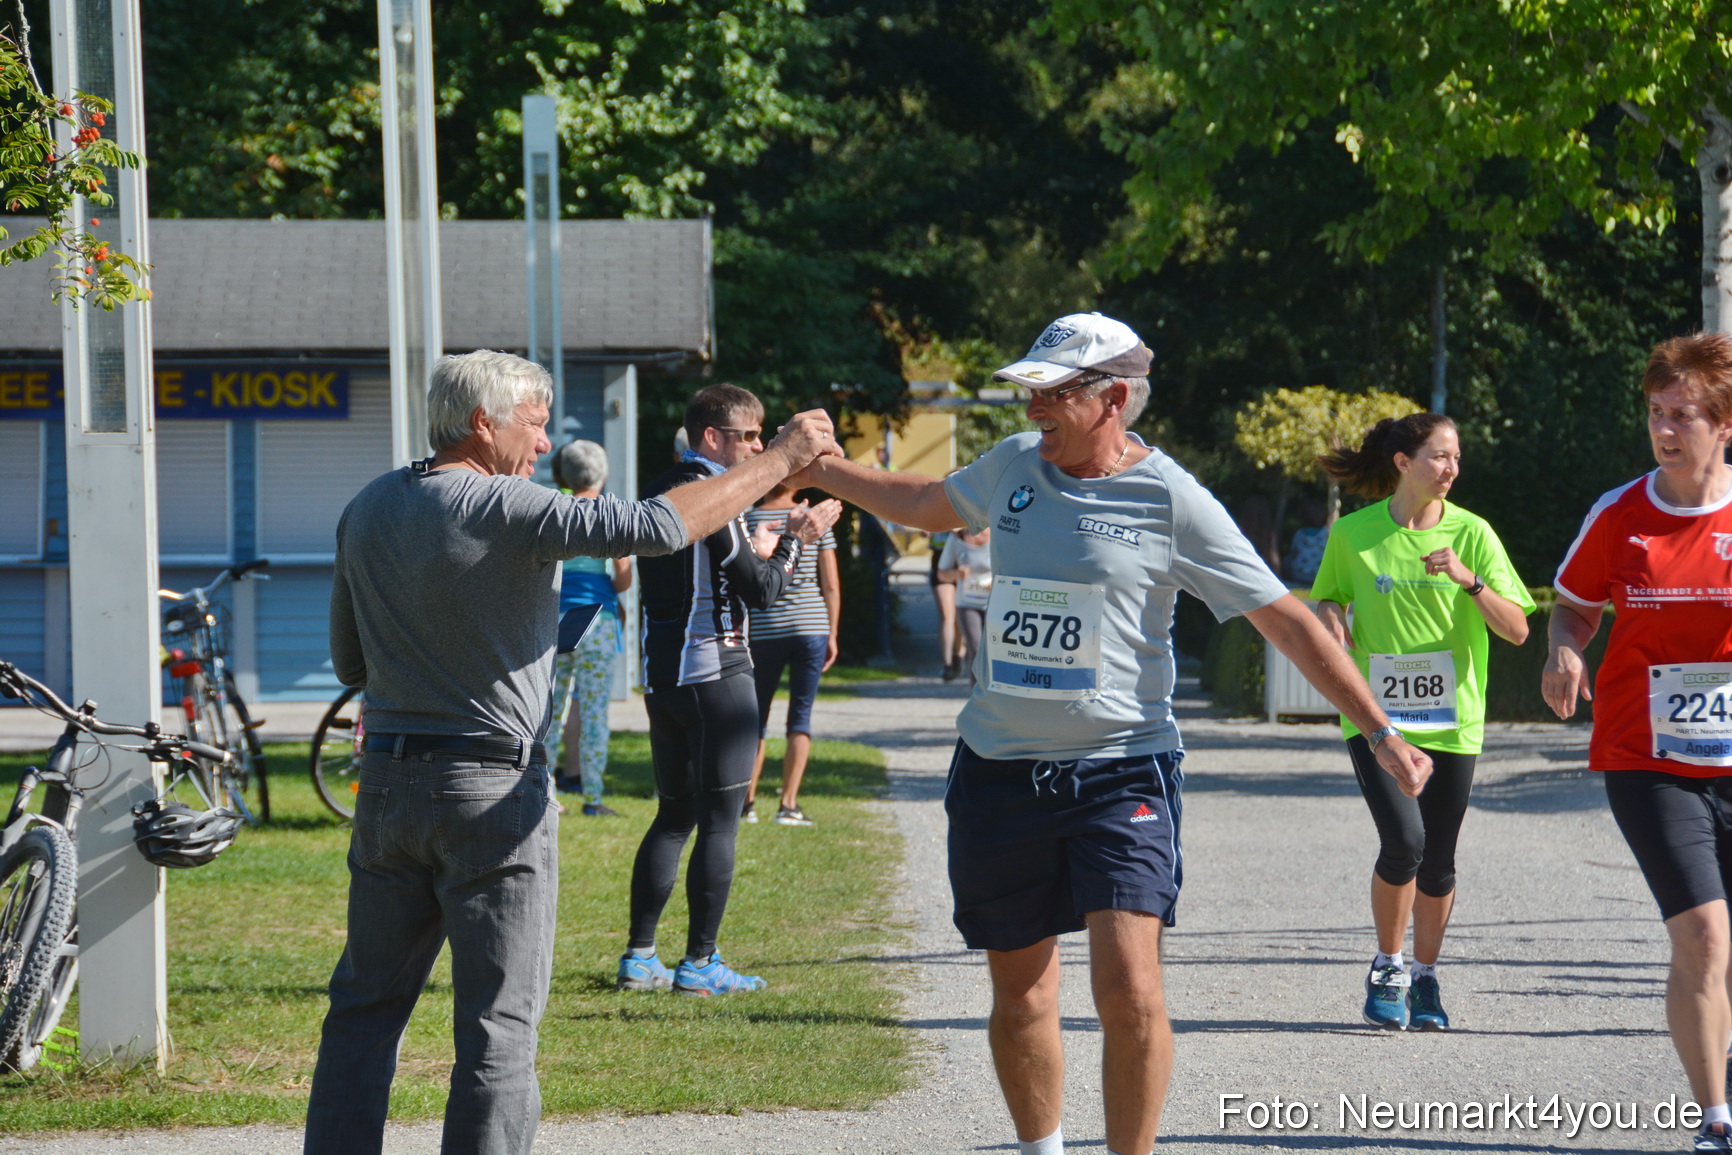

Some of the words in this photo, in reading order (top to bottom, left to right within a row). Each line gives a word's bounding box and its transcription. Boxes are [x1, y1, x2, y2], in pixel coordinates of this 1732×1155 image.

[212, 371, 338, 408] KIOSK
[1000, 515, 1021, 529] PARTL
[1078, 517, 1141, 546] BOCK
[1020, 588, 1068, 605] BOCK
[1626, 585, 1692, 595] ENGELHARDT
[1696, 587, 1703, 595] &
[1625, 602, 1661, 610] Amberg
[1002, 610, 1082, 651] 2578
[1008, 650, 1027, 660] PARTL
[1028, 653, 1062, 663] Neumarkt
[1394, 660, 1431, 671] BOCK
[1022, 669, 1052, 689] Jörg
[1683, 672, 1730, 685] BOCK
[1382, 675, 1444, 699] 2168
[1400, 712, 1429, 722] Maria
[1675, 727, 1699, 735] PARTL
[1685, 742, 1730, 757] Angela
[1130, 813, 1158, 823] adidas
